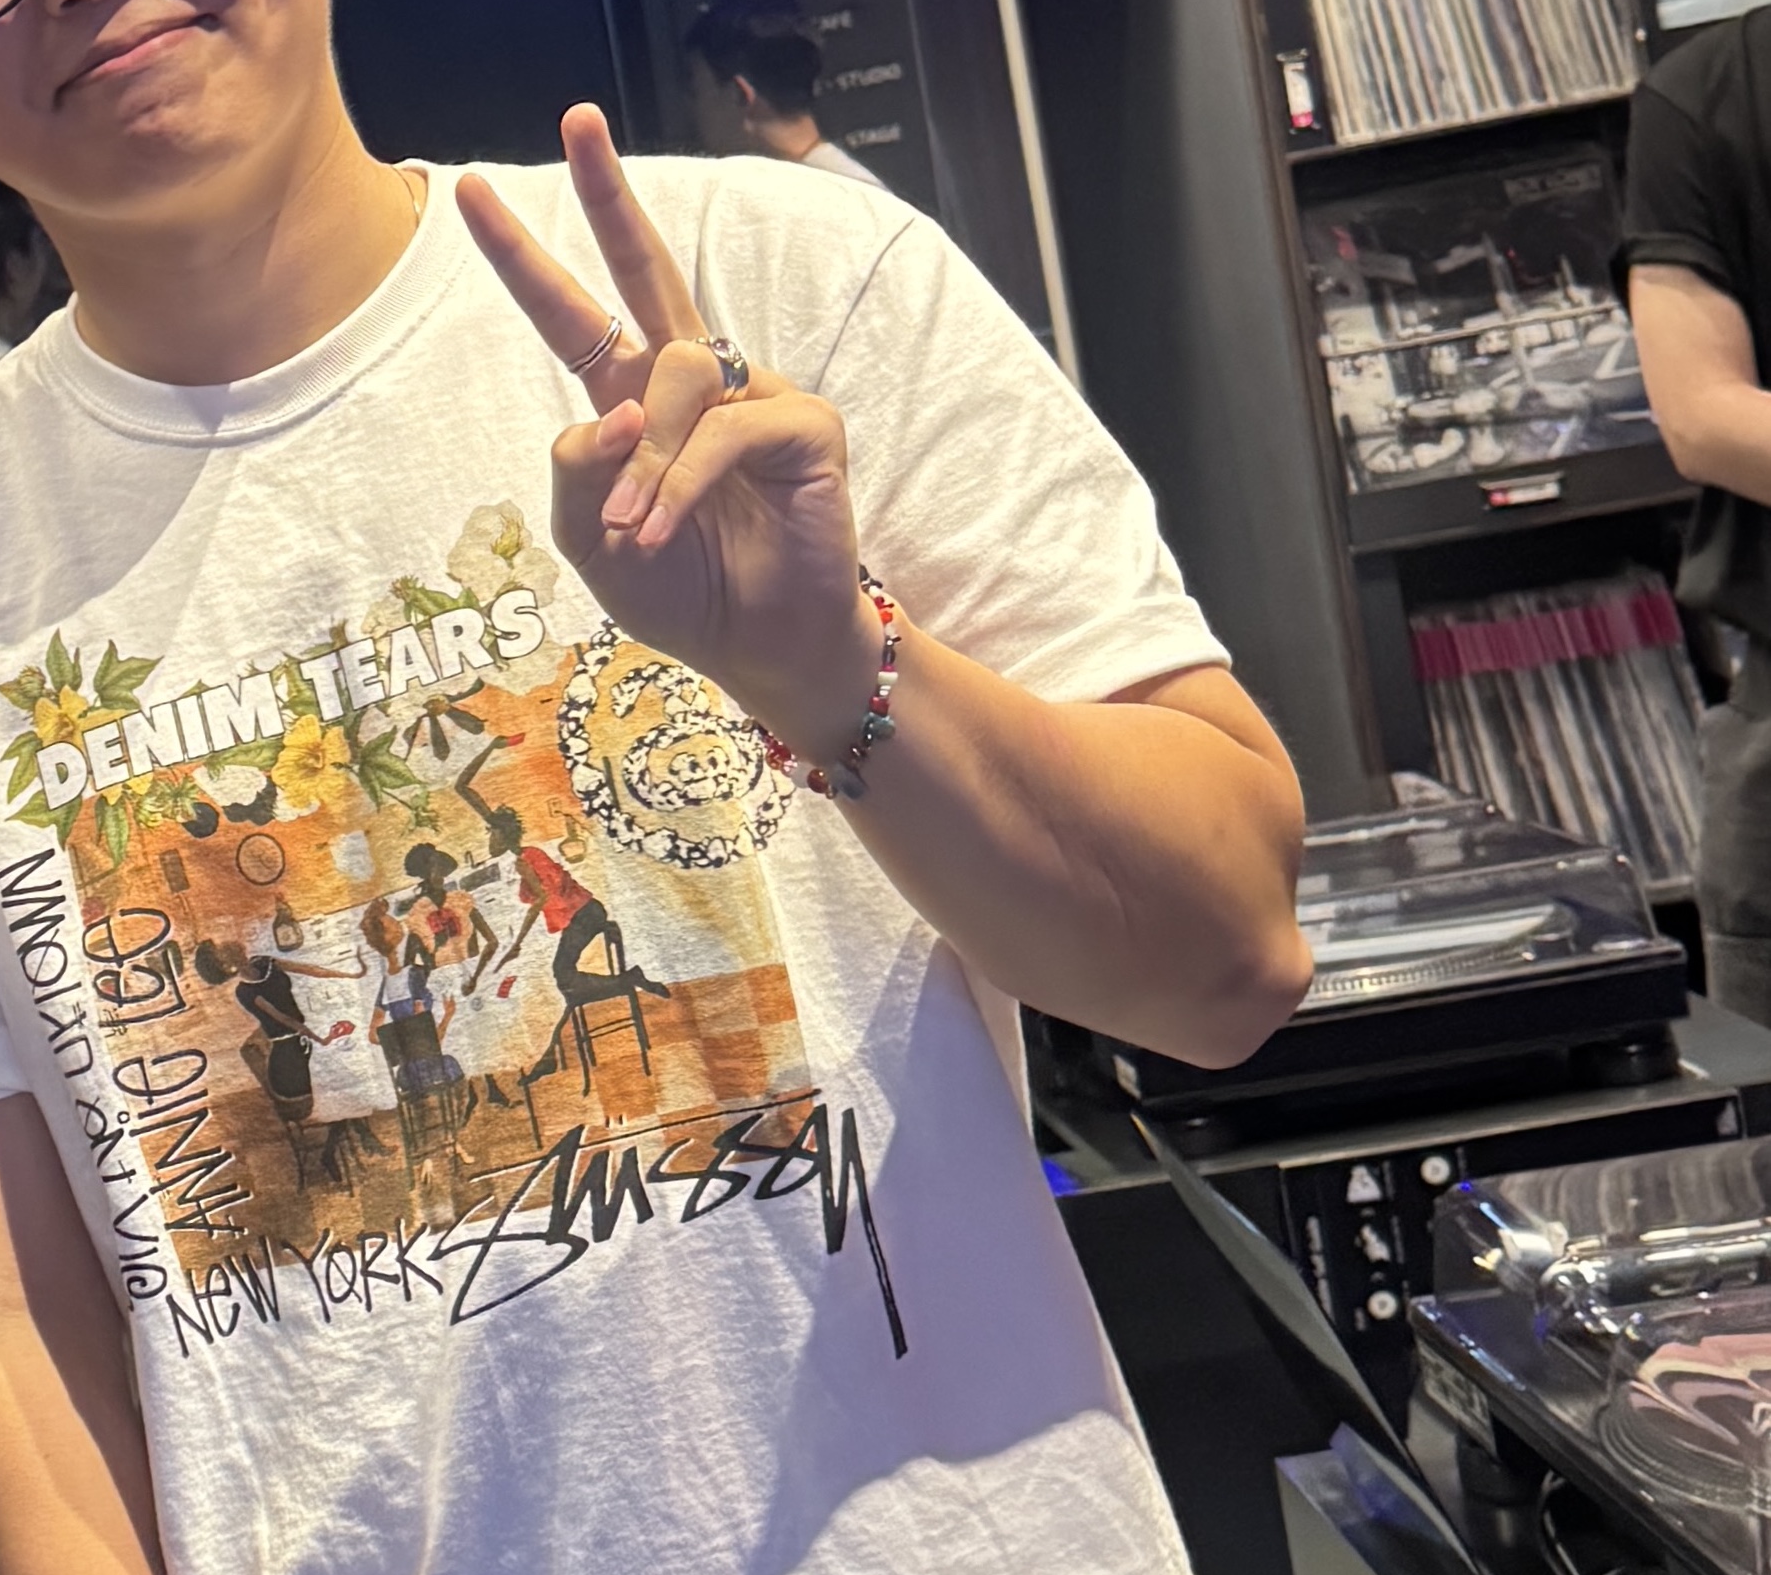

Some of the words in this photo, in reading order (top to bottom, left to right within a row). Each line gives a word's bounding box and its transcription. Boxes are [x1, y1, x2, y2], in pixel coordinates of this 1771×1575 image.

[35, 671, 286, 812] DENIM
[300, 587, 546, 723] TEARS
[302, 1218, 444, 1323] YORK
